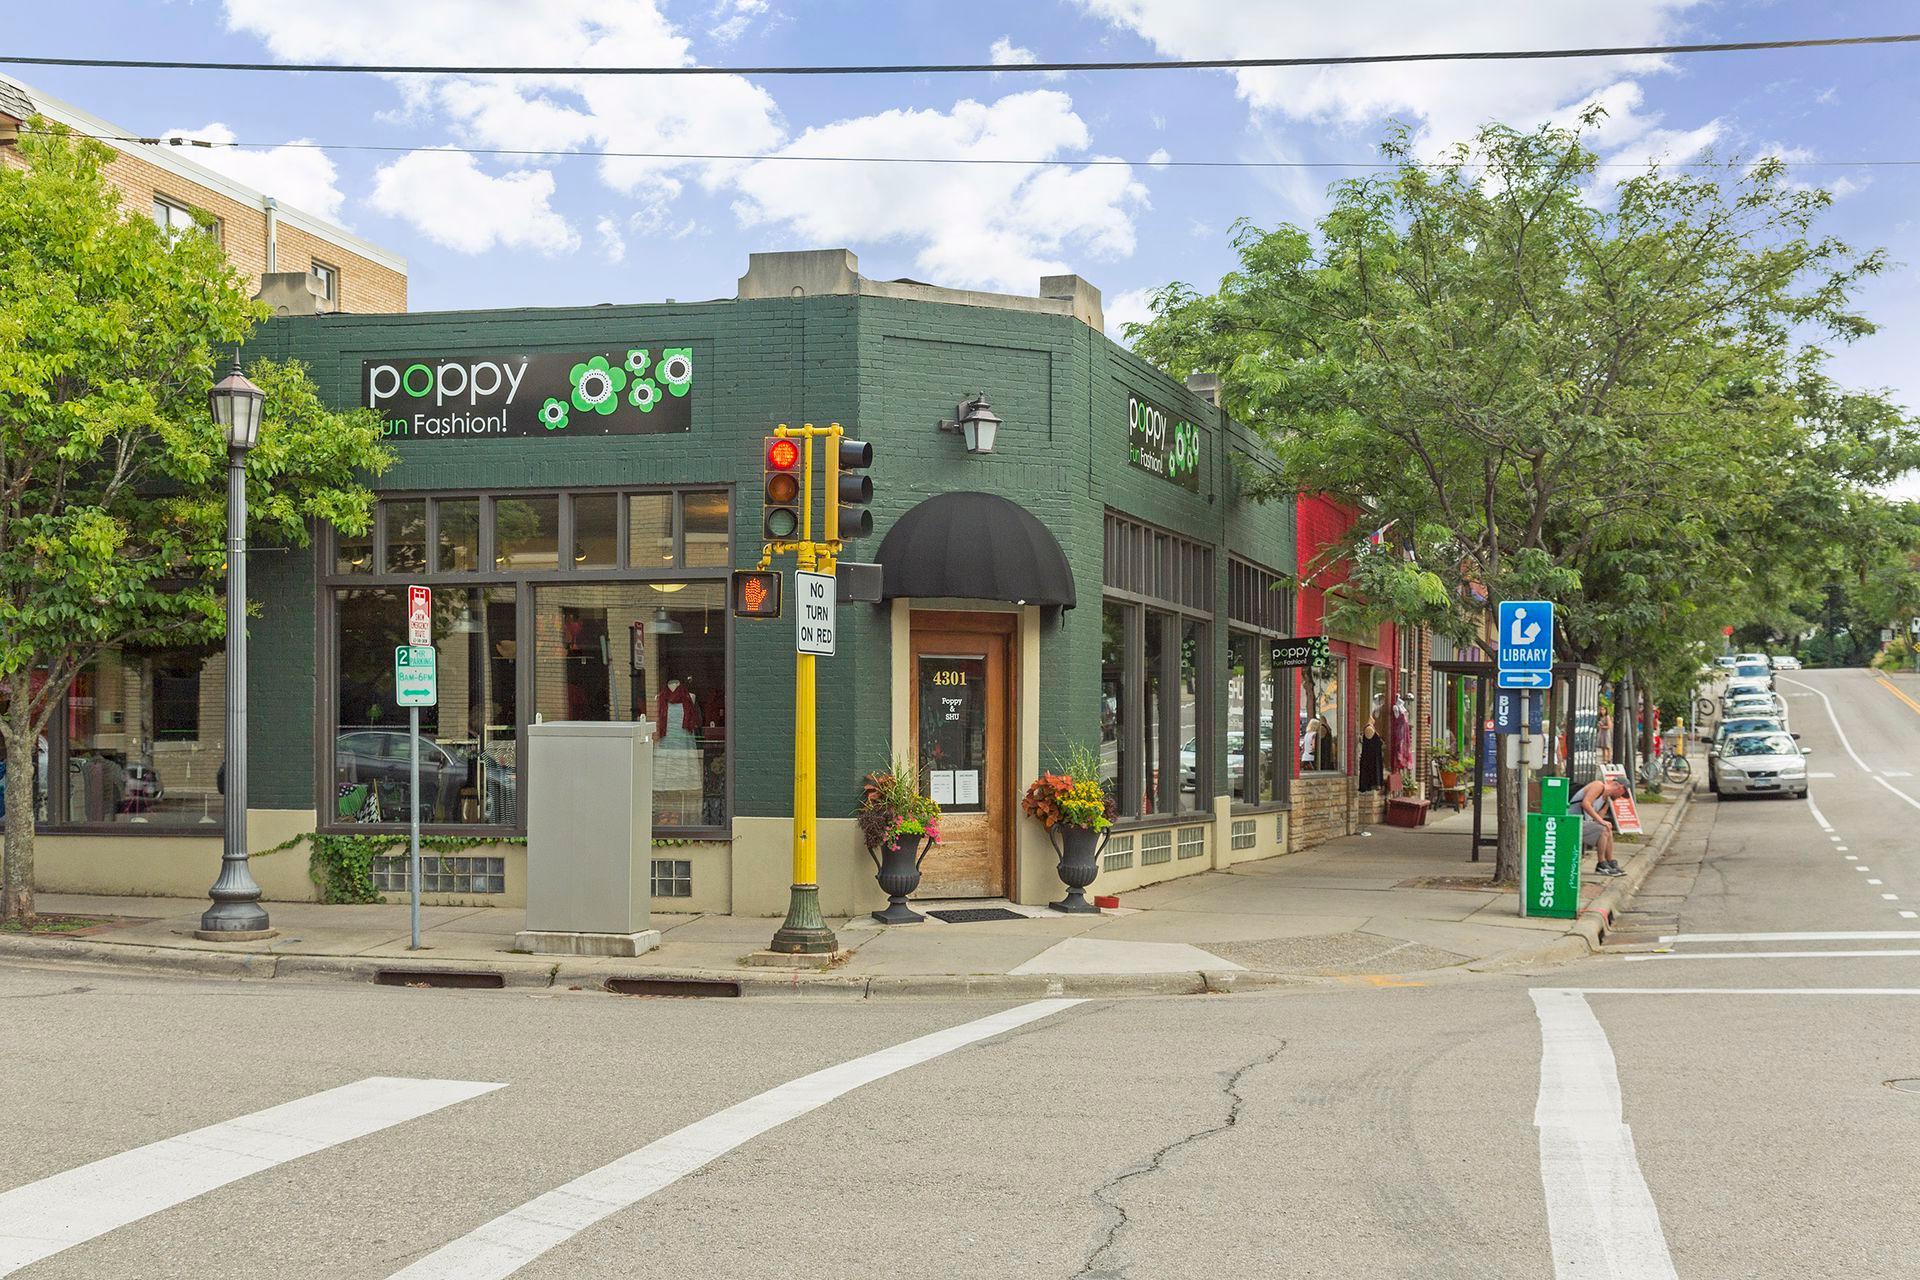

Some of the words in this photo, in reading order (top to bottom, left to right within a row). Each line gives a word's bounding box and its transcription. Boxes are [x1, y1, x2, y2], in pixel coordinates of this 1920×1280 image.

[370, 361, 528, 408] poppy
[380, 418, 408, 436] un
[414, 408, 507, 435] Fashion!
[1129, 397, 1167, 451] poppy
[1140, 447, 1164, 475] Fashion!
[810, 582, 824, 599] NO
[806, 604, 829, 621] TURN
[801, 626, 813, 642] ON
[816, 627, 833, 644] RED
[399, 650, 408, 665] 2
[1272, 647, 1310, 660] poppy
[1503, 648, 1548, 662] LIBRARY
[932, 670, 968, 686] 4301
[941, 697, 963, 706] Poppy
[949, 705, 956, 713] &
[945, 713, 960, 721] SHU
[1498, 695, 1510, 727] BUS
[1538, 819, 1557, 908] StarTribune
